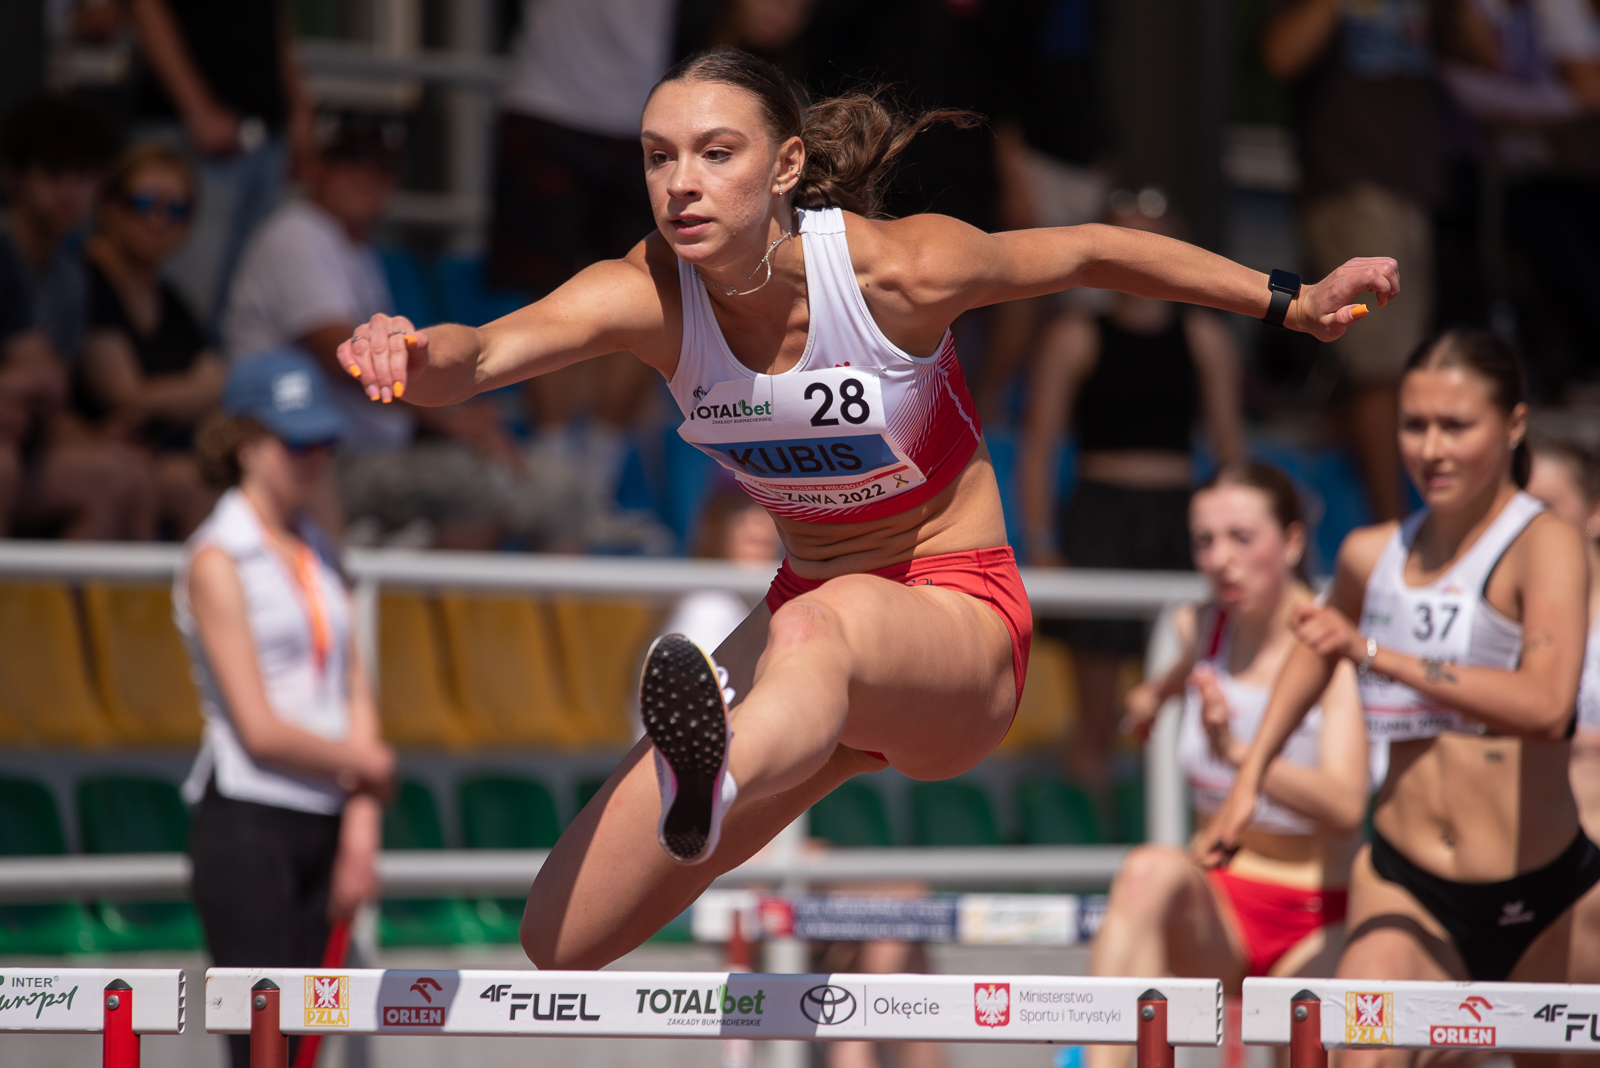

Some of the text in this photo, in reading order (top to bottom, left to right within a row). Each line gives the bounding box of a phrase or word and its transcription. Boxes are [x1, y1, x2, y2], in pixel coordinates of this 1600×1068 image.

[804, 378, 870, 427] 28
[728, 443, 862, 474] KUBIS
[838, 483, 886, 505] 2022
[1412, 603, 1460, 642] 37
[0, 985, 78, 1019] uropol
[479, 984, 512, 1002] 4F
[636, 984, 766, 1015] TOTALbet
[1019, 990, 1093, 1004] Ministerstwo
[386, 1009, 441, 1024] ORLEN
[509, 993, 601, 1021] FUEL
[873, 997, 939, 1018] Okęcie
[1533, 1003, 1568, 1022] 4F
[306, 1010, 346, 1024] PZLA
[667, 1018, 762, 1027] ZAKŁADY BUKMACHERSKIE
[1019, 1009, 1059, 1025] Sportu
[1068, 1009, 1121, 1025] Turystyki
[1347, 1028, 1390, 1043] PZLA
[1432, 1027, 1493, 1044] ORLEN
